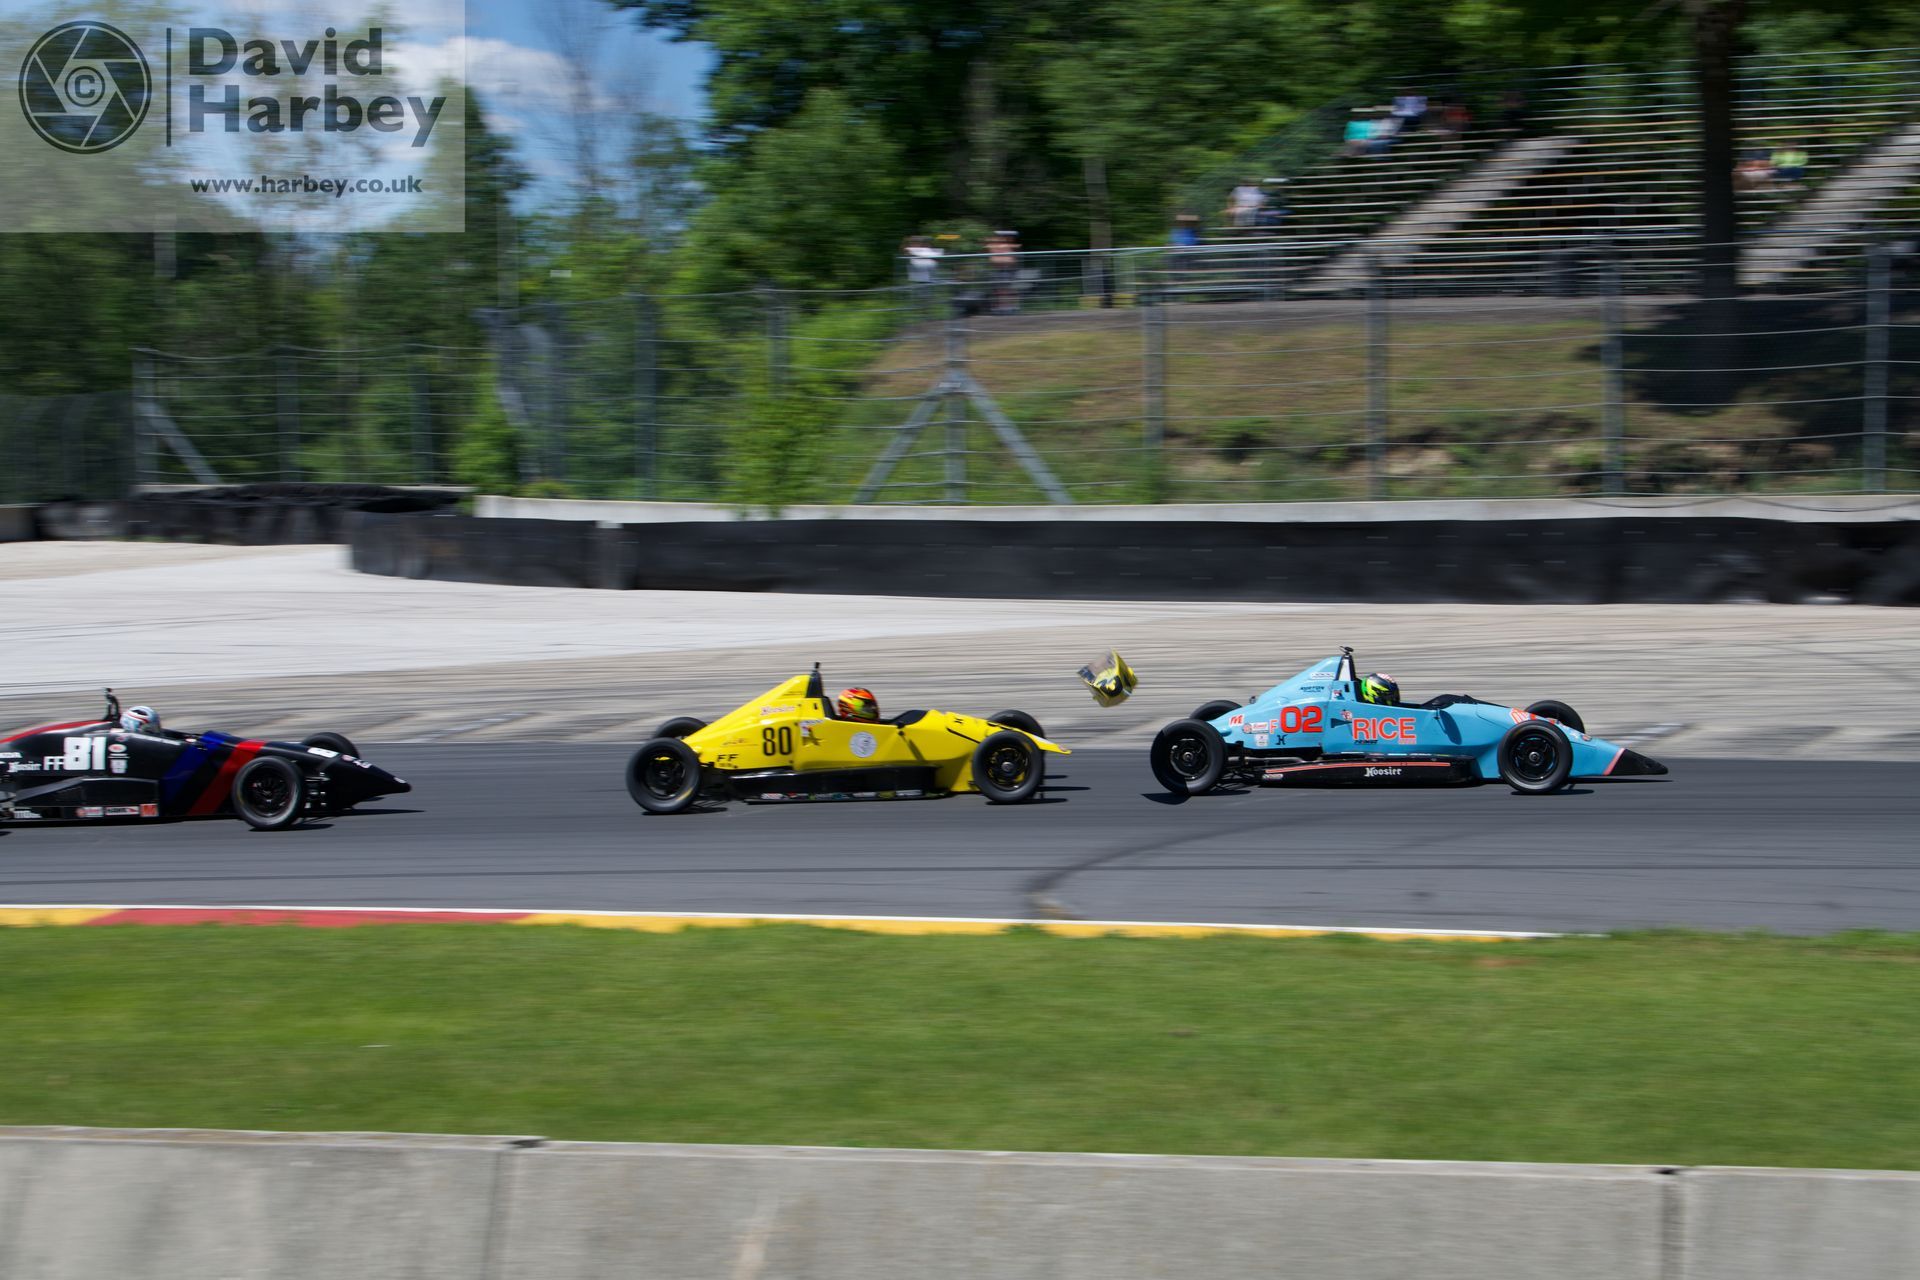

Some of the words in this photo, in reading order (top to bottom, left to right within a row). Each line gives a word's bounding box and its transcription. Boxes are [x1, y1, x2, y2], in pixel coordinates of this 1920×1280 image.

[1280, 706, 1323, 733] 02
[1352, 717, 1417, 740] RICE
[63, 737, 107, 770] 81
[762, 726, 792, 756] 80
[1364, 767, 1402, 777] Hoosier
